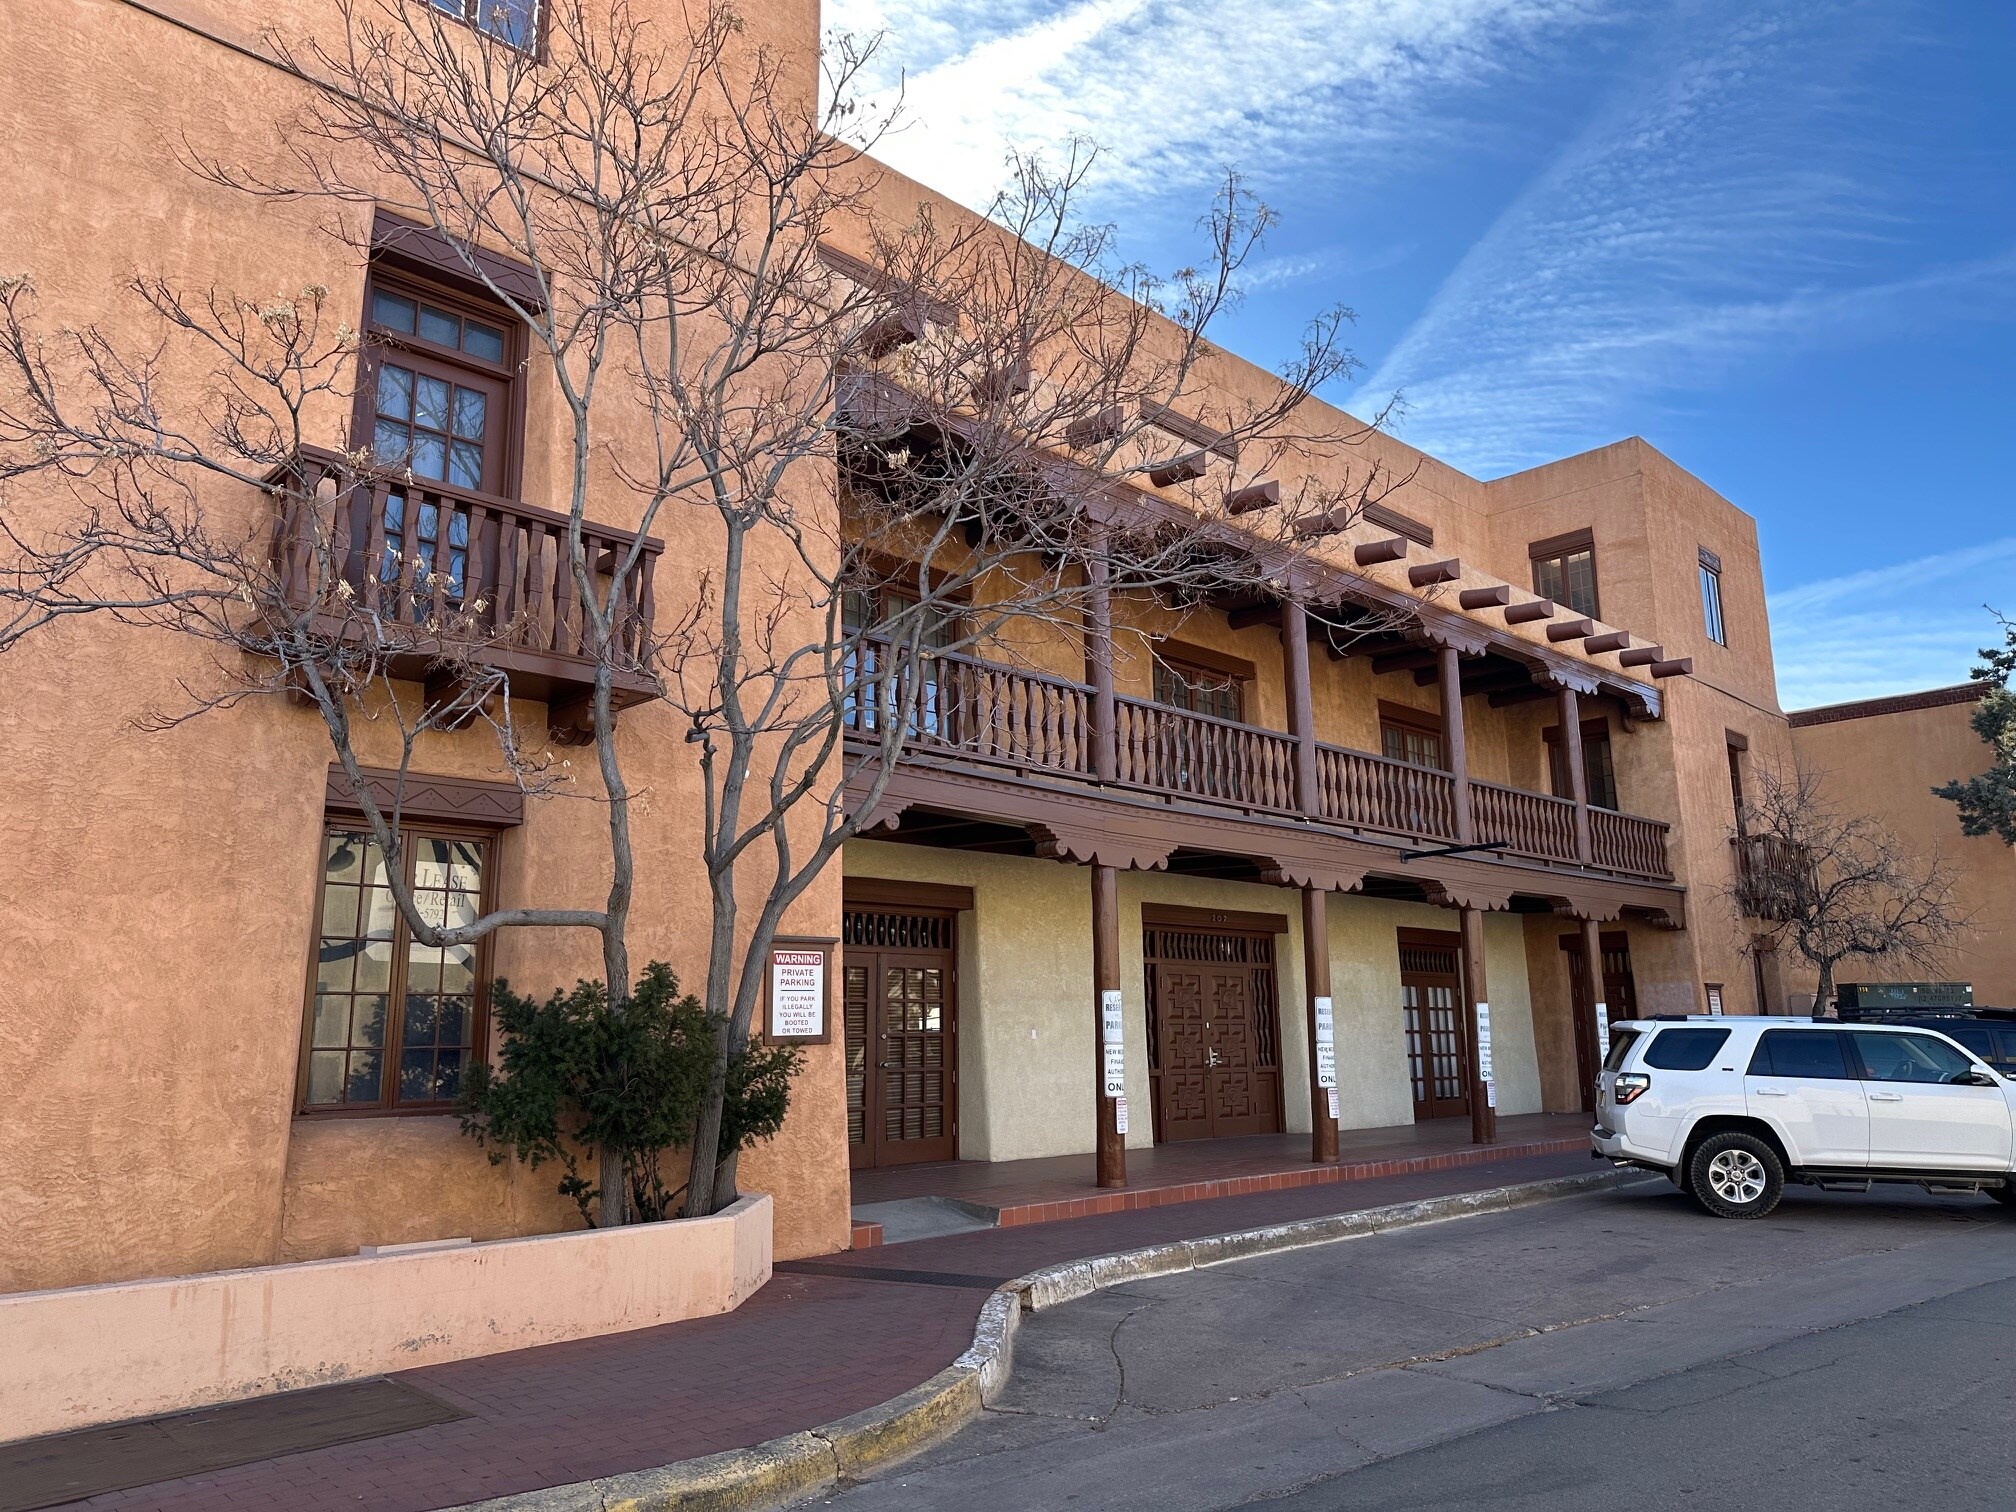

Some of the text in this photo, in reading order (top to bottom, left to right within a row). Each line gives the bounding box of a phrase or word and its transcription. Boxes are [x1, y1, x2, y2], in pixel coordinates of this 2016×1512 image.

[421, 868, 467, 890] LEASE
[1212, 914, 1227, 922] 207
[775, 954, 821, 965] WARNING
[781, 969, 814, 977] PRIVATE
[780, 979, 815, 987] PARKING
